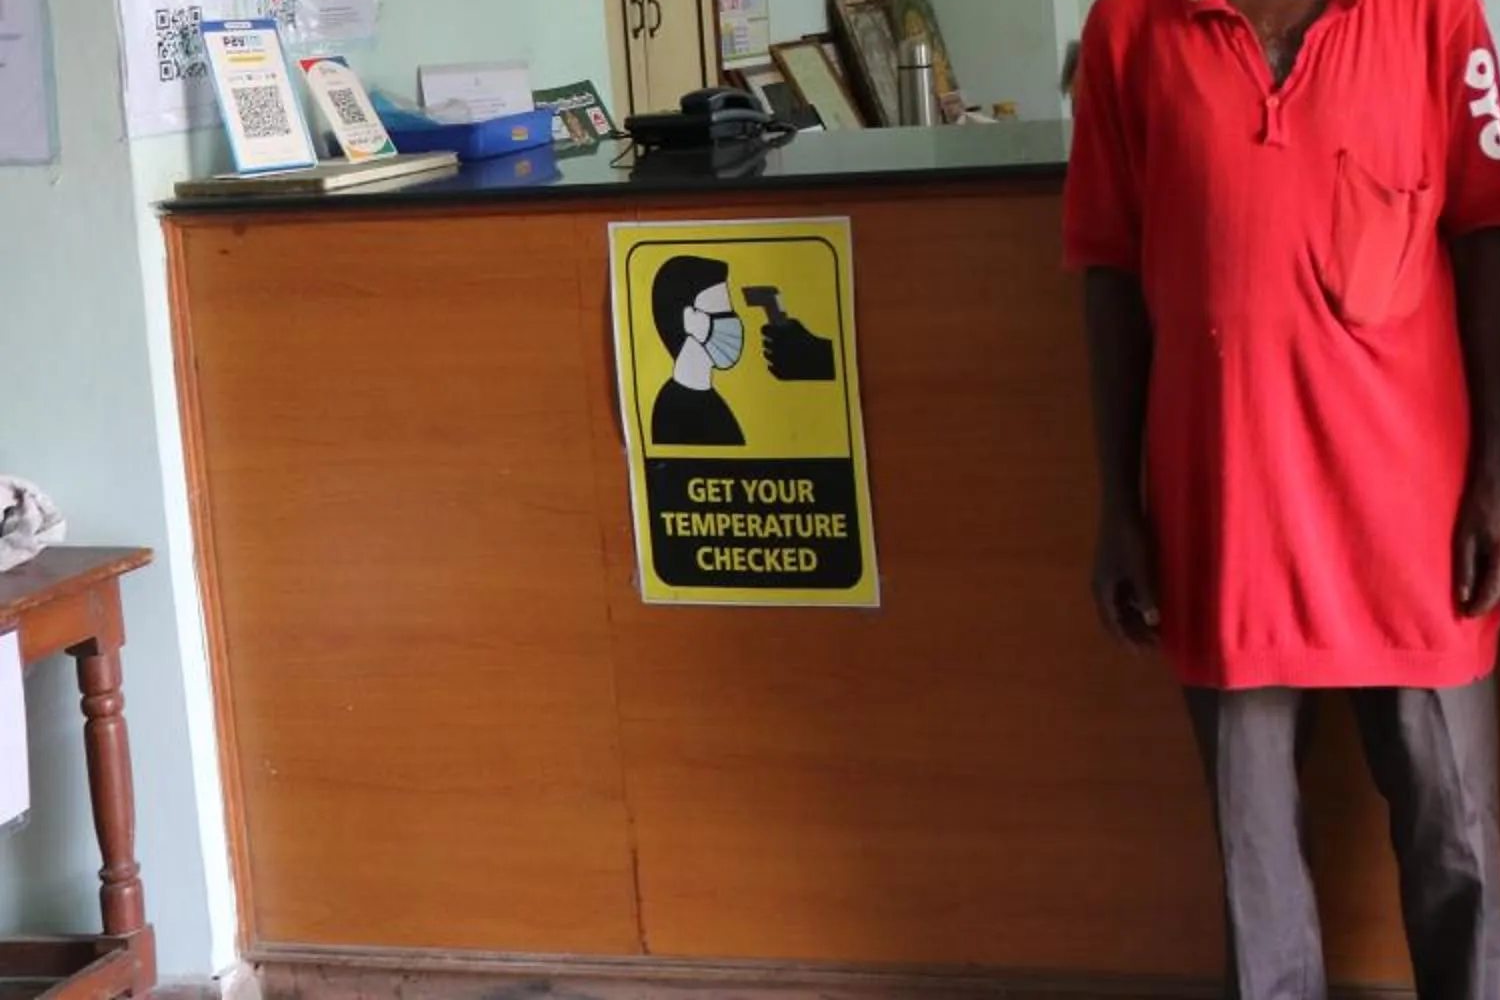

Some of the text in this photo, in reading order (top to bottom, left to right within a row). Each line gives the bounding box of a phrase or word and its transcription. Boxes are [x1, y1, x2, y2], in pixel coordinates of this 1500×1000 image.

[687, 477, 815, 503] GET YOUR
[660, 511, 848, 538] TEMPERATURE
[696, 545, 818, 572] CHECKED
